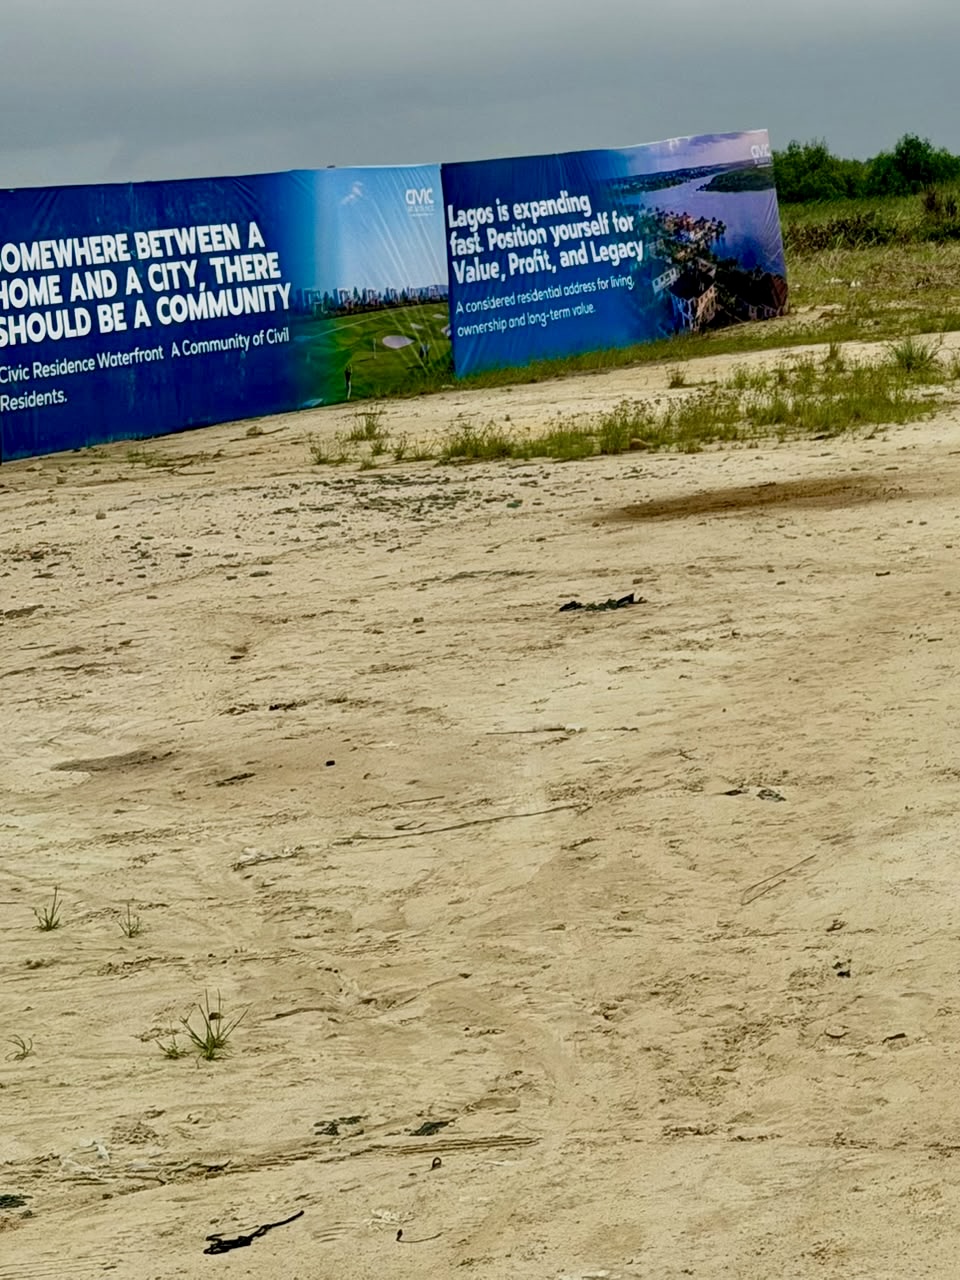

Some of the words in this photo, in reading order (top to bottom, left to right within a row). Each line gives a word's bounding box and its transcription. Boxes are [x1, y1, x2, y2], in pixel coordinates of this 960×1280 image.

[447, 204, 494, 232] Lagos
[495, 197, 510, 222] is
[512, 190, 592, 224] expanding
[450, 231, 484, 256] fast.
[486, 222, 547, 251] Position
[549, 211, 610, 247] yourself
[612, 210, 634, 233] for
[0, 233, 131, 273] OMEWHERE
[134, 223, 241, 260] BETWEEN
[248, 221, 265, 248] A
[452, 256, 506, 284] Value,
[508, 249, 557, 276] Profit,
[560, 240, 588, 267] and
[589, 239, 643, 266] Legacy
[70, 269, 118, 302] AND
[125, 266, 143, 295] A
[148, 260, 206, 292] CITY,
[210, 252, 282, 284] THERE
[455, 301, 464, 314] A
[465, 291, 516, 312] considered
[517, 283, 562, 303] residential
[563, 281, 596, 297] address
[597, 277, 609, 290] for
[0, 308, 91, 348] SHOULD
[97, 302, 127, 334] BE
[134, 300, 152, 328] A
[156, 283, 291, 324] COMMUNITY
[457, 317, 507, 337] ownership
[508, 313, 526, 328] and
[527, 308, 571, 328] long-term
[0, 365, 30, 383] Civic
[33, 358, 95, 379] Residence
[97, 345, 164, 369] Waterfront
[171, 342, 181, 358] A
[182, 332, 250, 355] Community
[252, 329, 265, 346] of
[266, 327, 289, 344] Civil
[0, 388, 68, 412] Residents.
